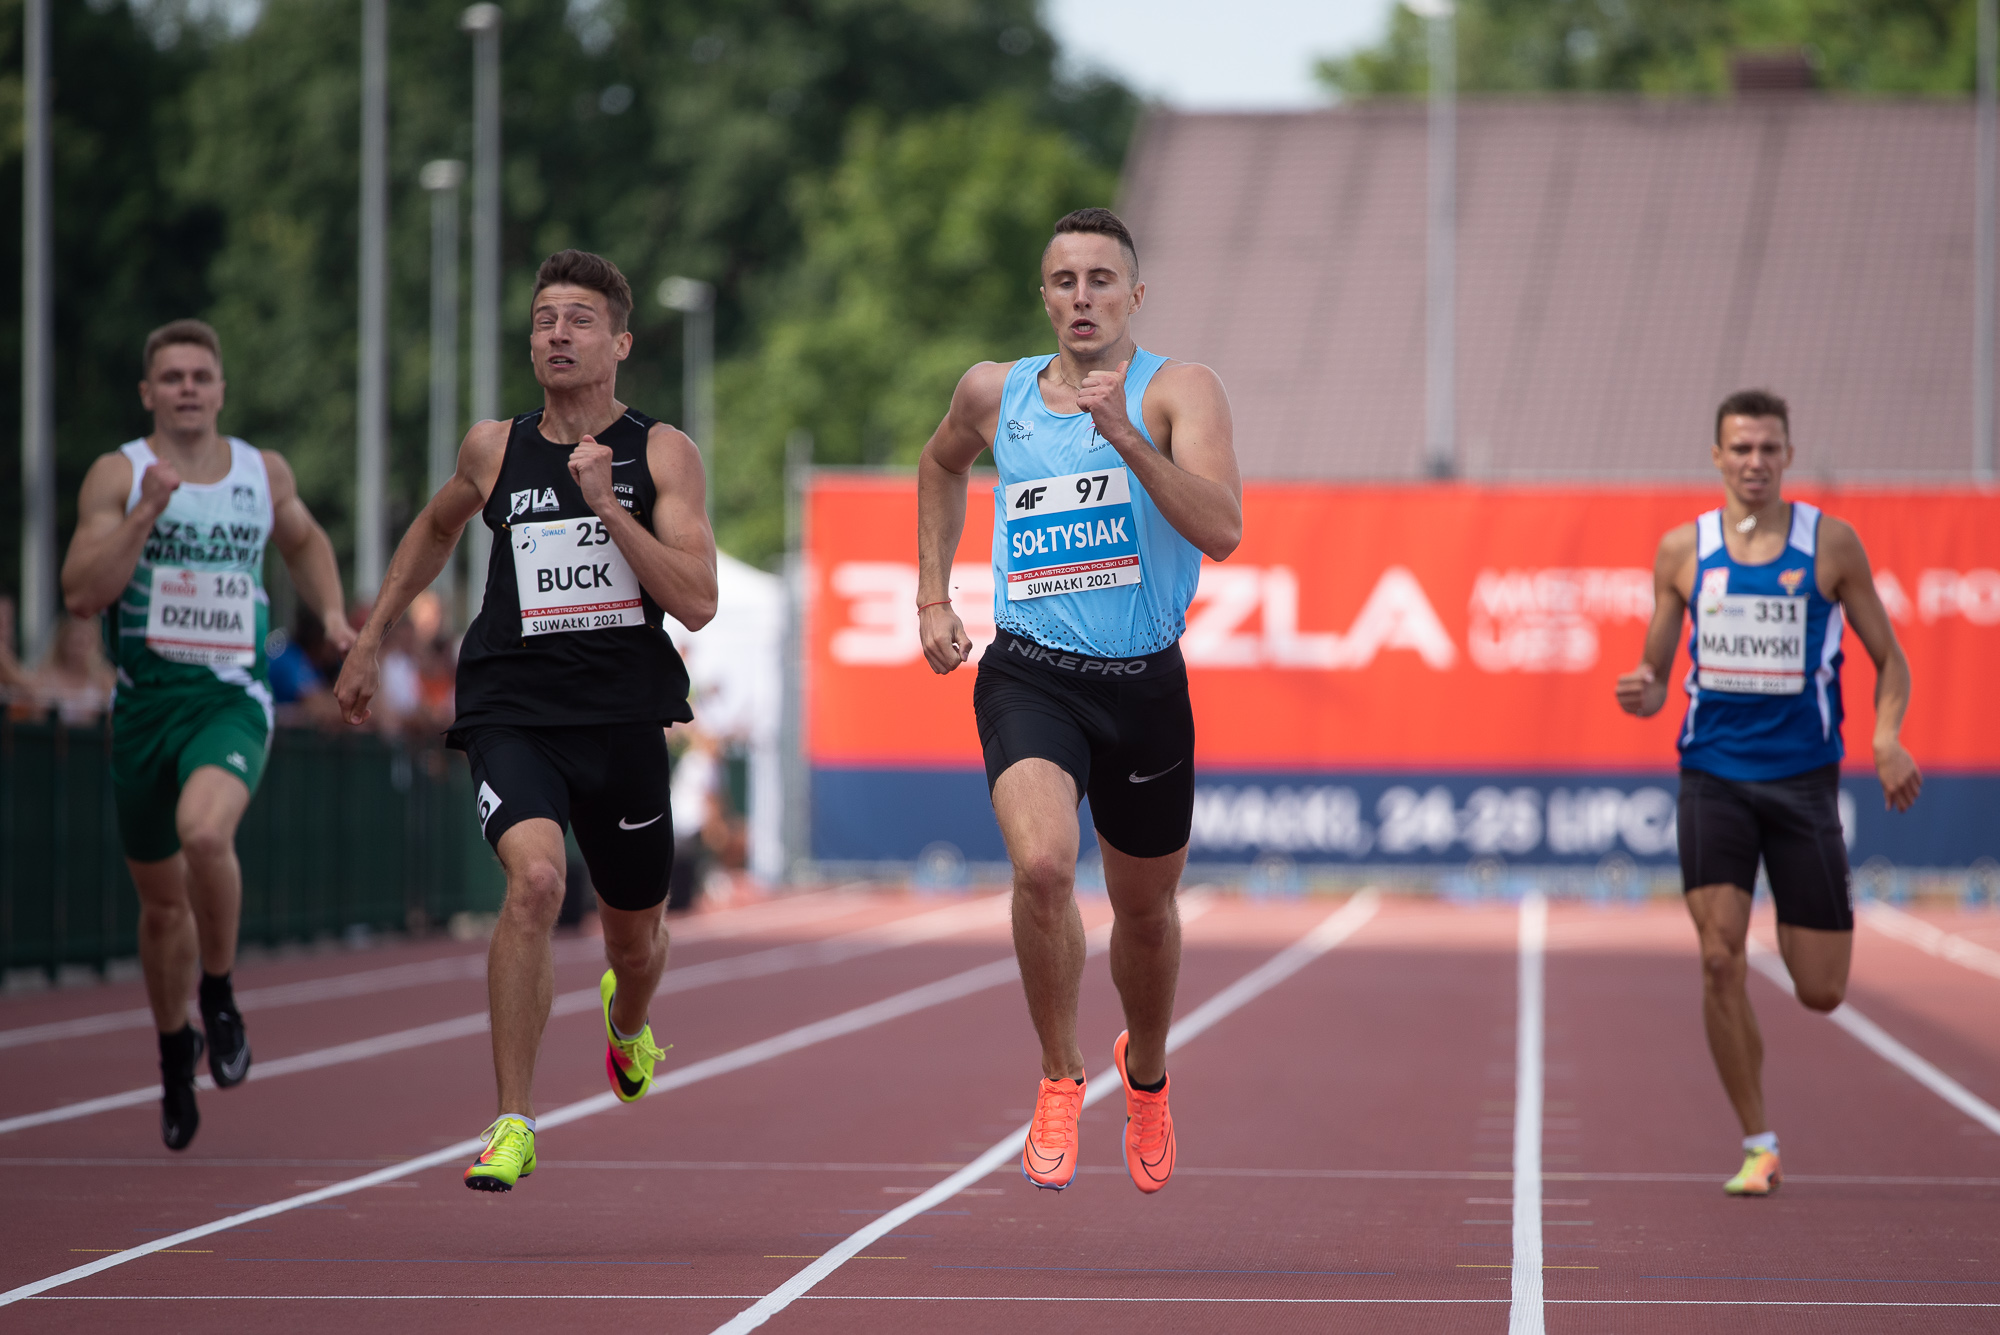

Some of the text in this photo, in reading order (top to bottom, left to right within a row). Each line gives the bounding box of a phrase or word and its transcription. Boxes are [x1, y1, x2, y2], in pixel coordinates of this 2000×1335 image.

[1016, 475, 1109, 511] 4F 97
[1012, 516, 1129, 558] SOŁTYSIAK
[537, 563, 613, 593] BUCK
[1040, 565, 1090, 576] MISTRZOSTWA
[1091, 561, 1116, 570] POLSKI
[1117, 558, 1134, 566] U23
[214, 575, 249, 599] 163
[1027, 572, 1117, 596] SUWAŁKI 2021
[160, 605, 244, 632] DZIUBA
[546, 605, 598, 615] MISTRZOSTWA
[598, 602, 624, 610] POLSKI
[1755, 601, 1798, 623] 331
[532, 613, 623, 632] SUWAŁKI 2021
[1007, 638, 1147, 676] NIKE PRO
[1702, 633, 1799, 659] MAJEWSKI
[1548, 785, 1677, 855] LIPC
